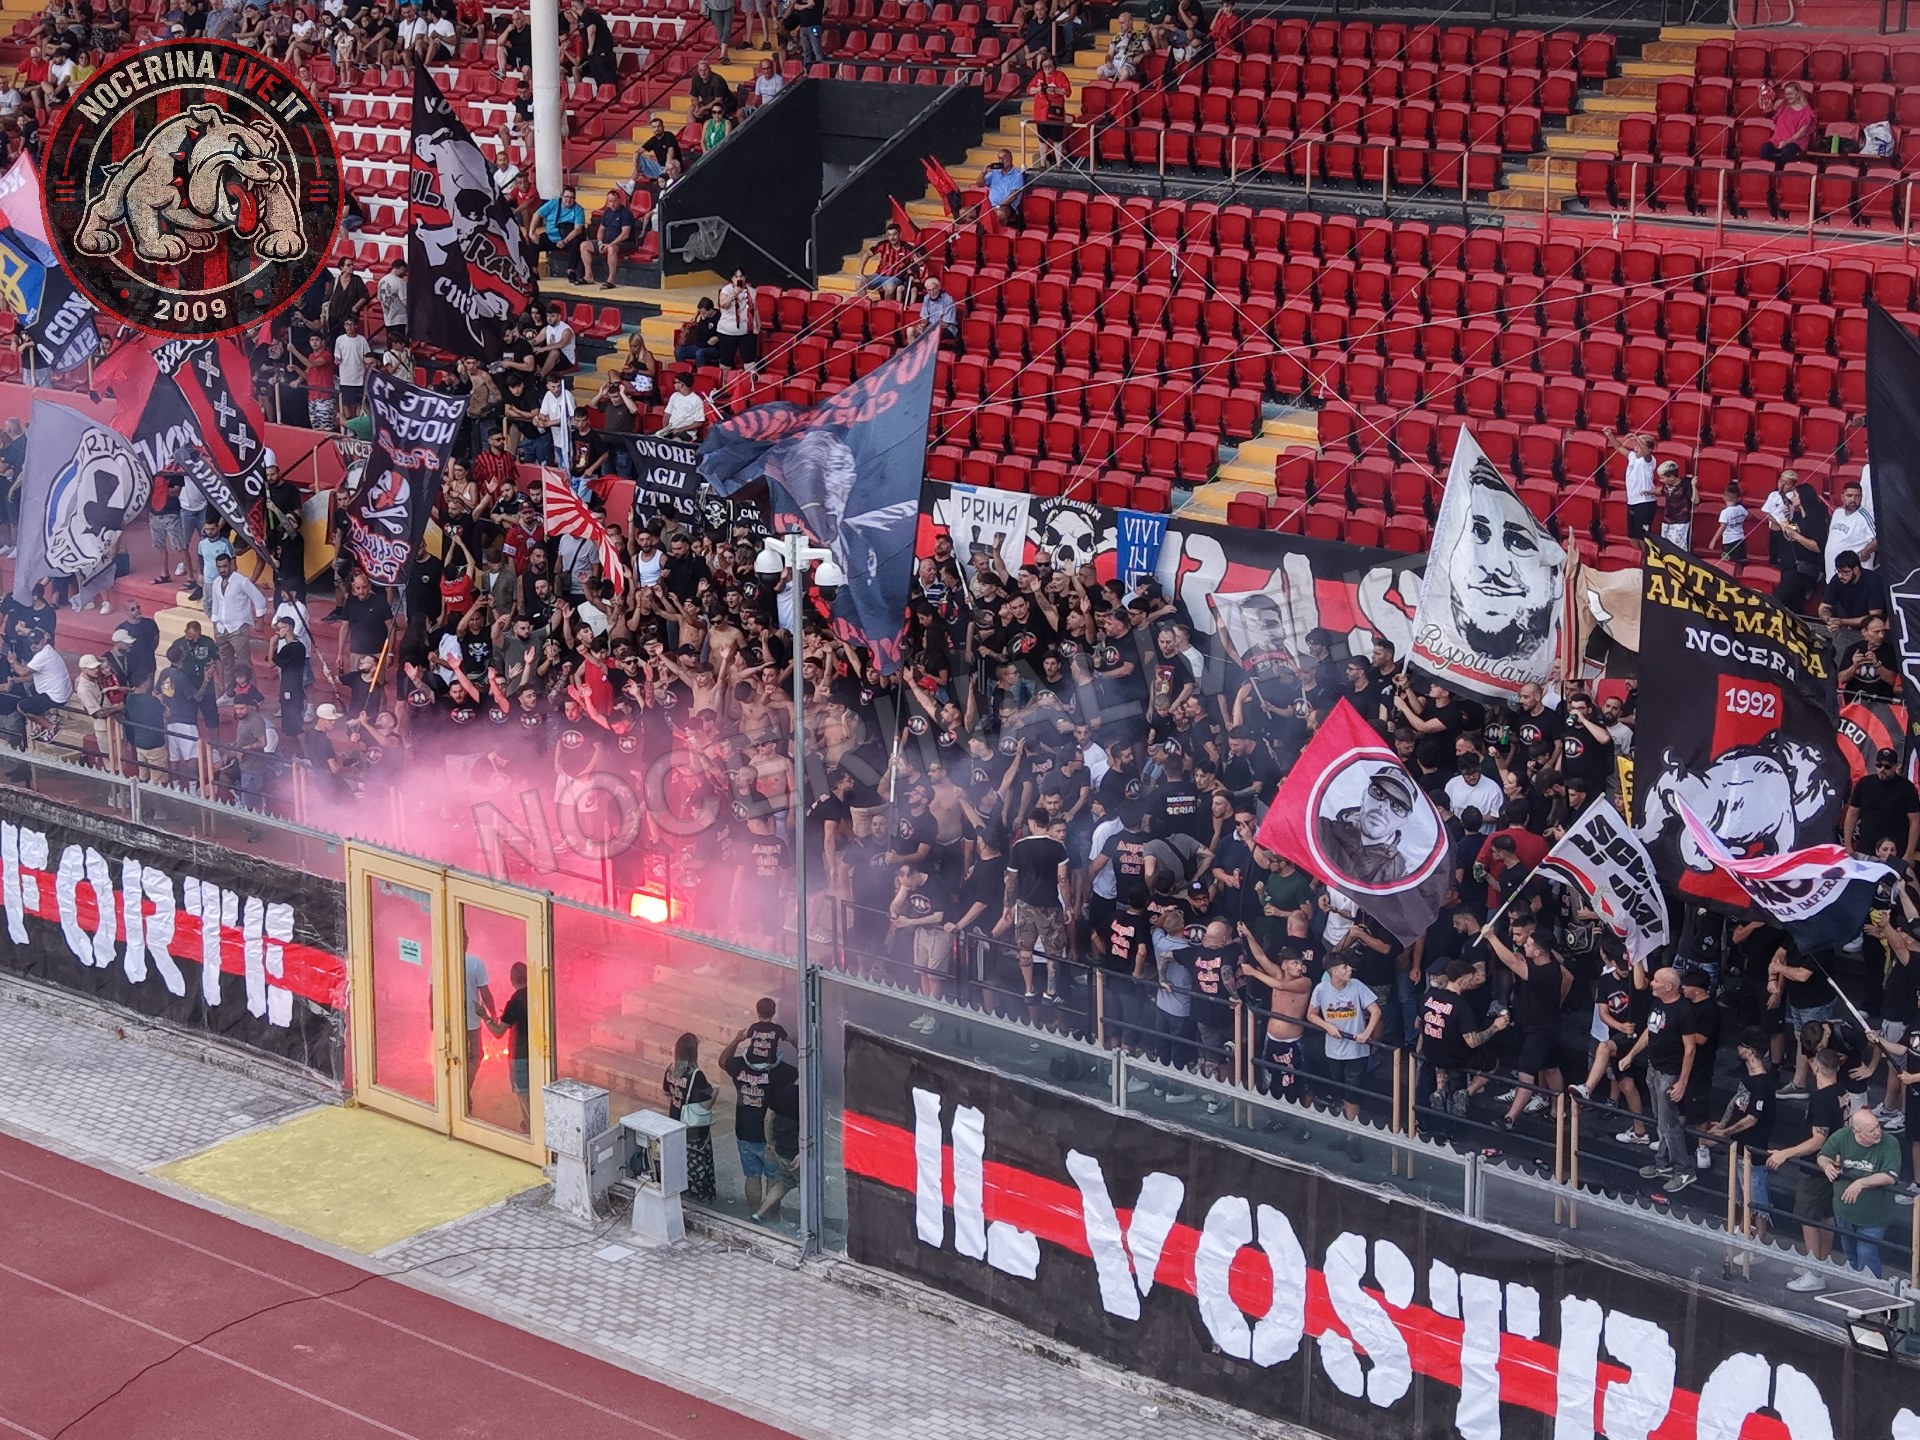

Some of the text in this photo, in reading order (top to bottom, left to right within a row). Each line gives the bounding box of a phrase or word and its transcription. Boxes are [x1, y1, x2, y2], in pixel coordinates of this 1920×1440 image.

[636, 439, 696, 465] ONORE
[635, 485, 694, 516] LTRAS
[961, 496, 1018, 527] PRIMA
[1124, 517, 1159, 546] VIVI
[1128, 546, 1148, 569] IN
[1415, 624, 1491, 672] Rispoli
[1684, 626, 1797, 683] NOCERA
[1725, 687, 1776, 719] 1992
[1836, 719, 1867, 746] IRO
[1796, 879, 1840, 911] IMPER
[1, 819, 295, 1028] FORTE
[912, 1087, 1836, 1440] IL VOSTRO
